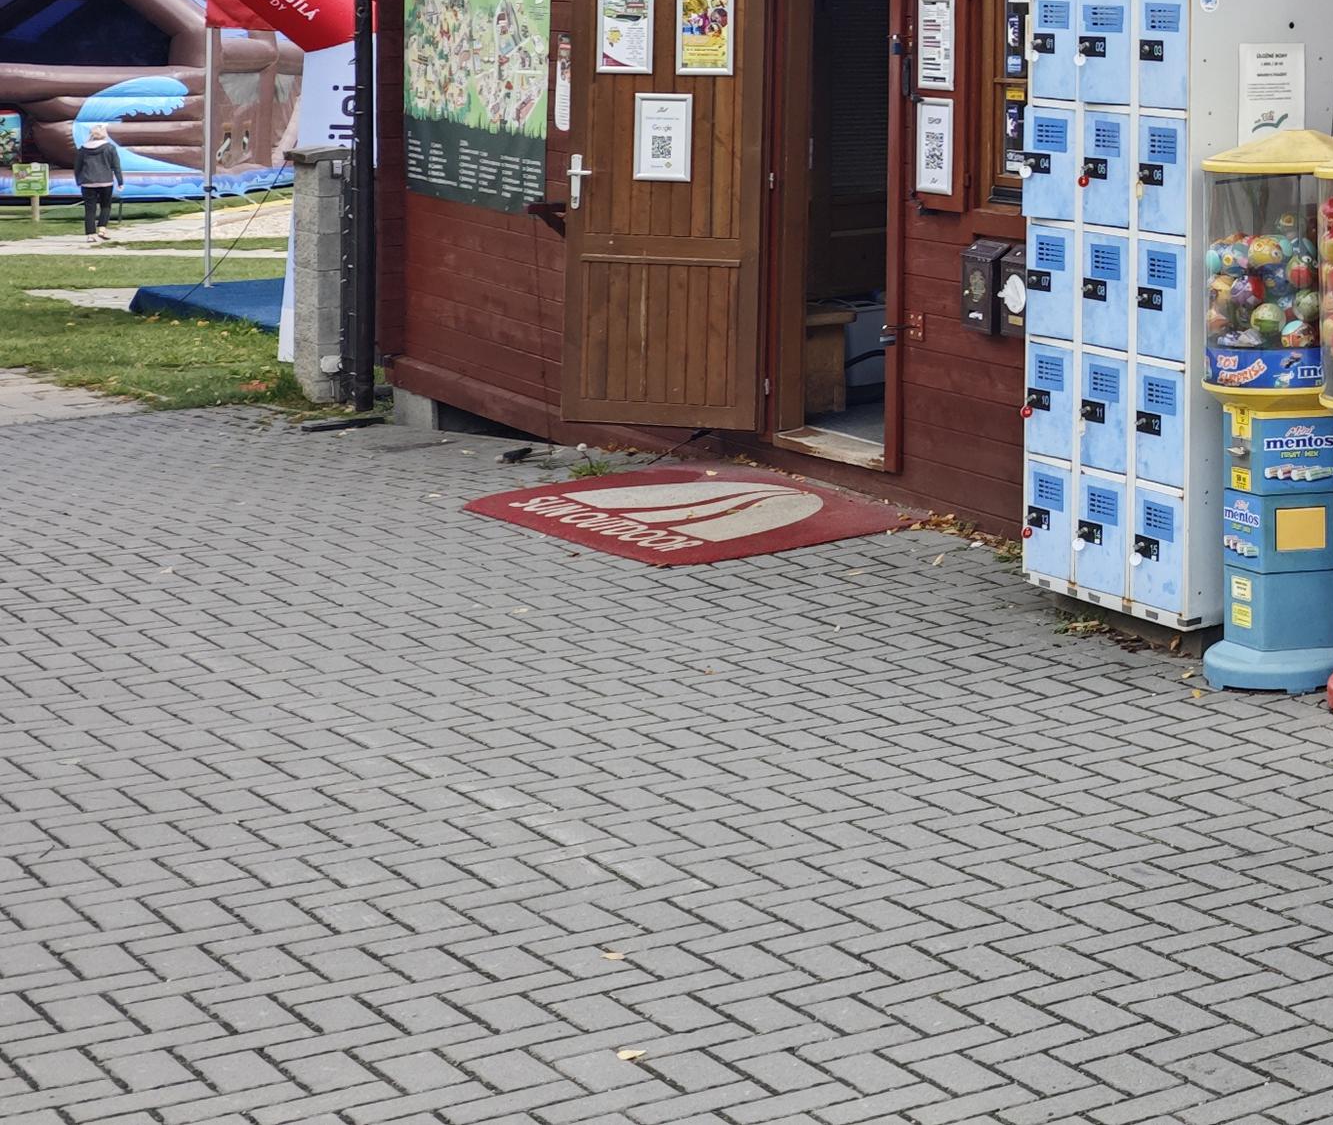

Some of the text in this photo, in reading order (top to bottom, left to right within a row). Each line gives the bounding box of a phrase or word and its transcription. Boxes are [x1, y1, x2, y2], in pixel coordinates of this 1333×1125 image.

[1095, 42, 1105, 52] 02
[1153, 46, 1162, 56] 03
[1040, 158, 1050, 169] 04
[1097, 164, 1106, 175] 05
[1153, 170, 1162, 181] 06
[1041, 276, 1050, 287] 07
[1097, 285, 1106, 296] 08
[1152, 294, 1162, 306] 09
[1217, 355, 1238, 369] TOY
[1042, 395, 1050, 406] 10
[1096, 407, 1104, 418] 11
[1151, 418, 1160, 431] 12
[1042, 513, 1049, 525] 13
[1224, 507, 1259, 526] mentos
[508, 496, 704, 552] SUNOUTDOOR
[1150, 544, 1158, 556] 15
